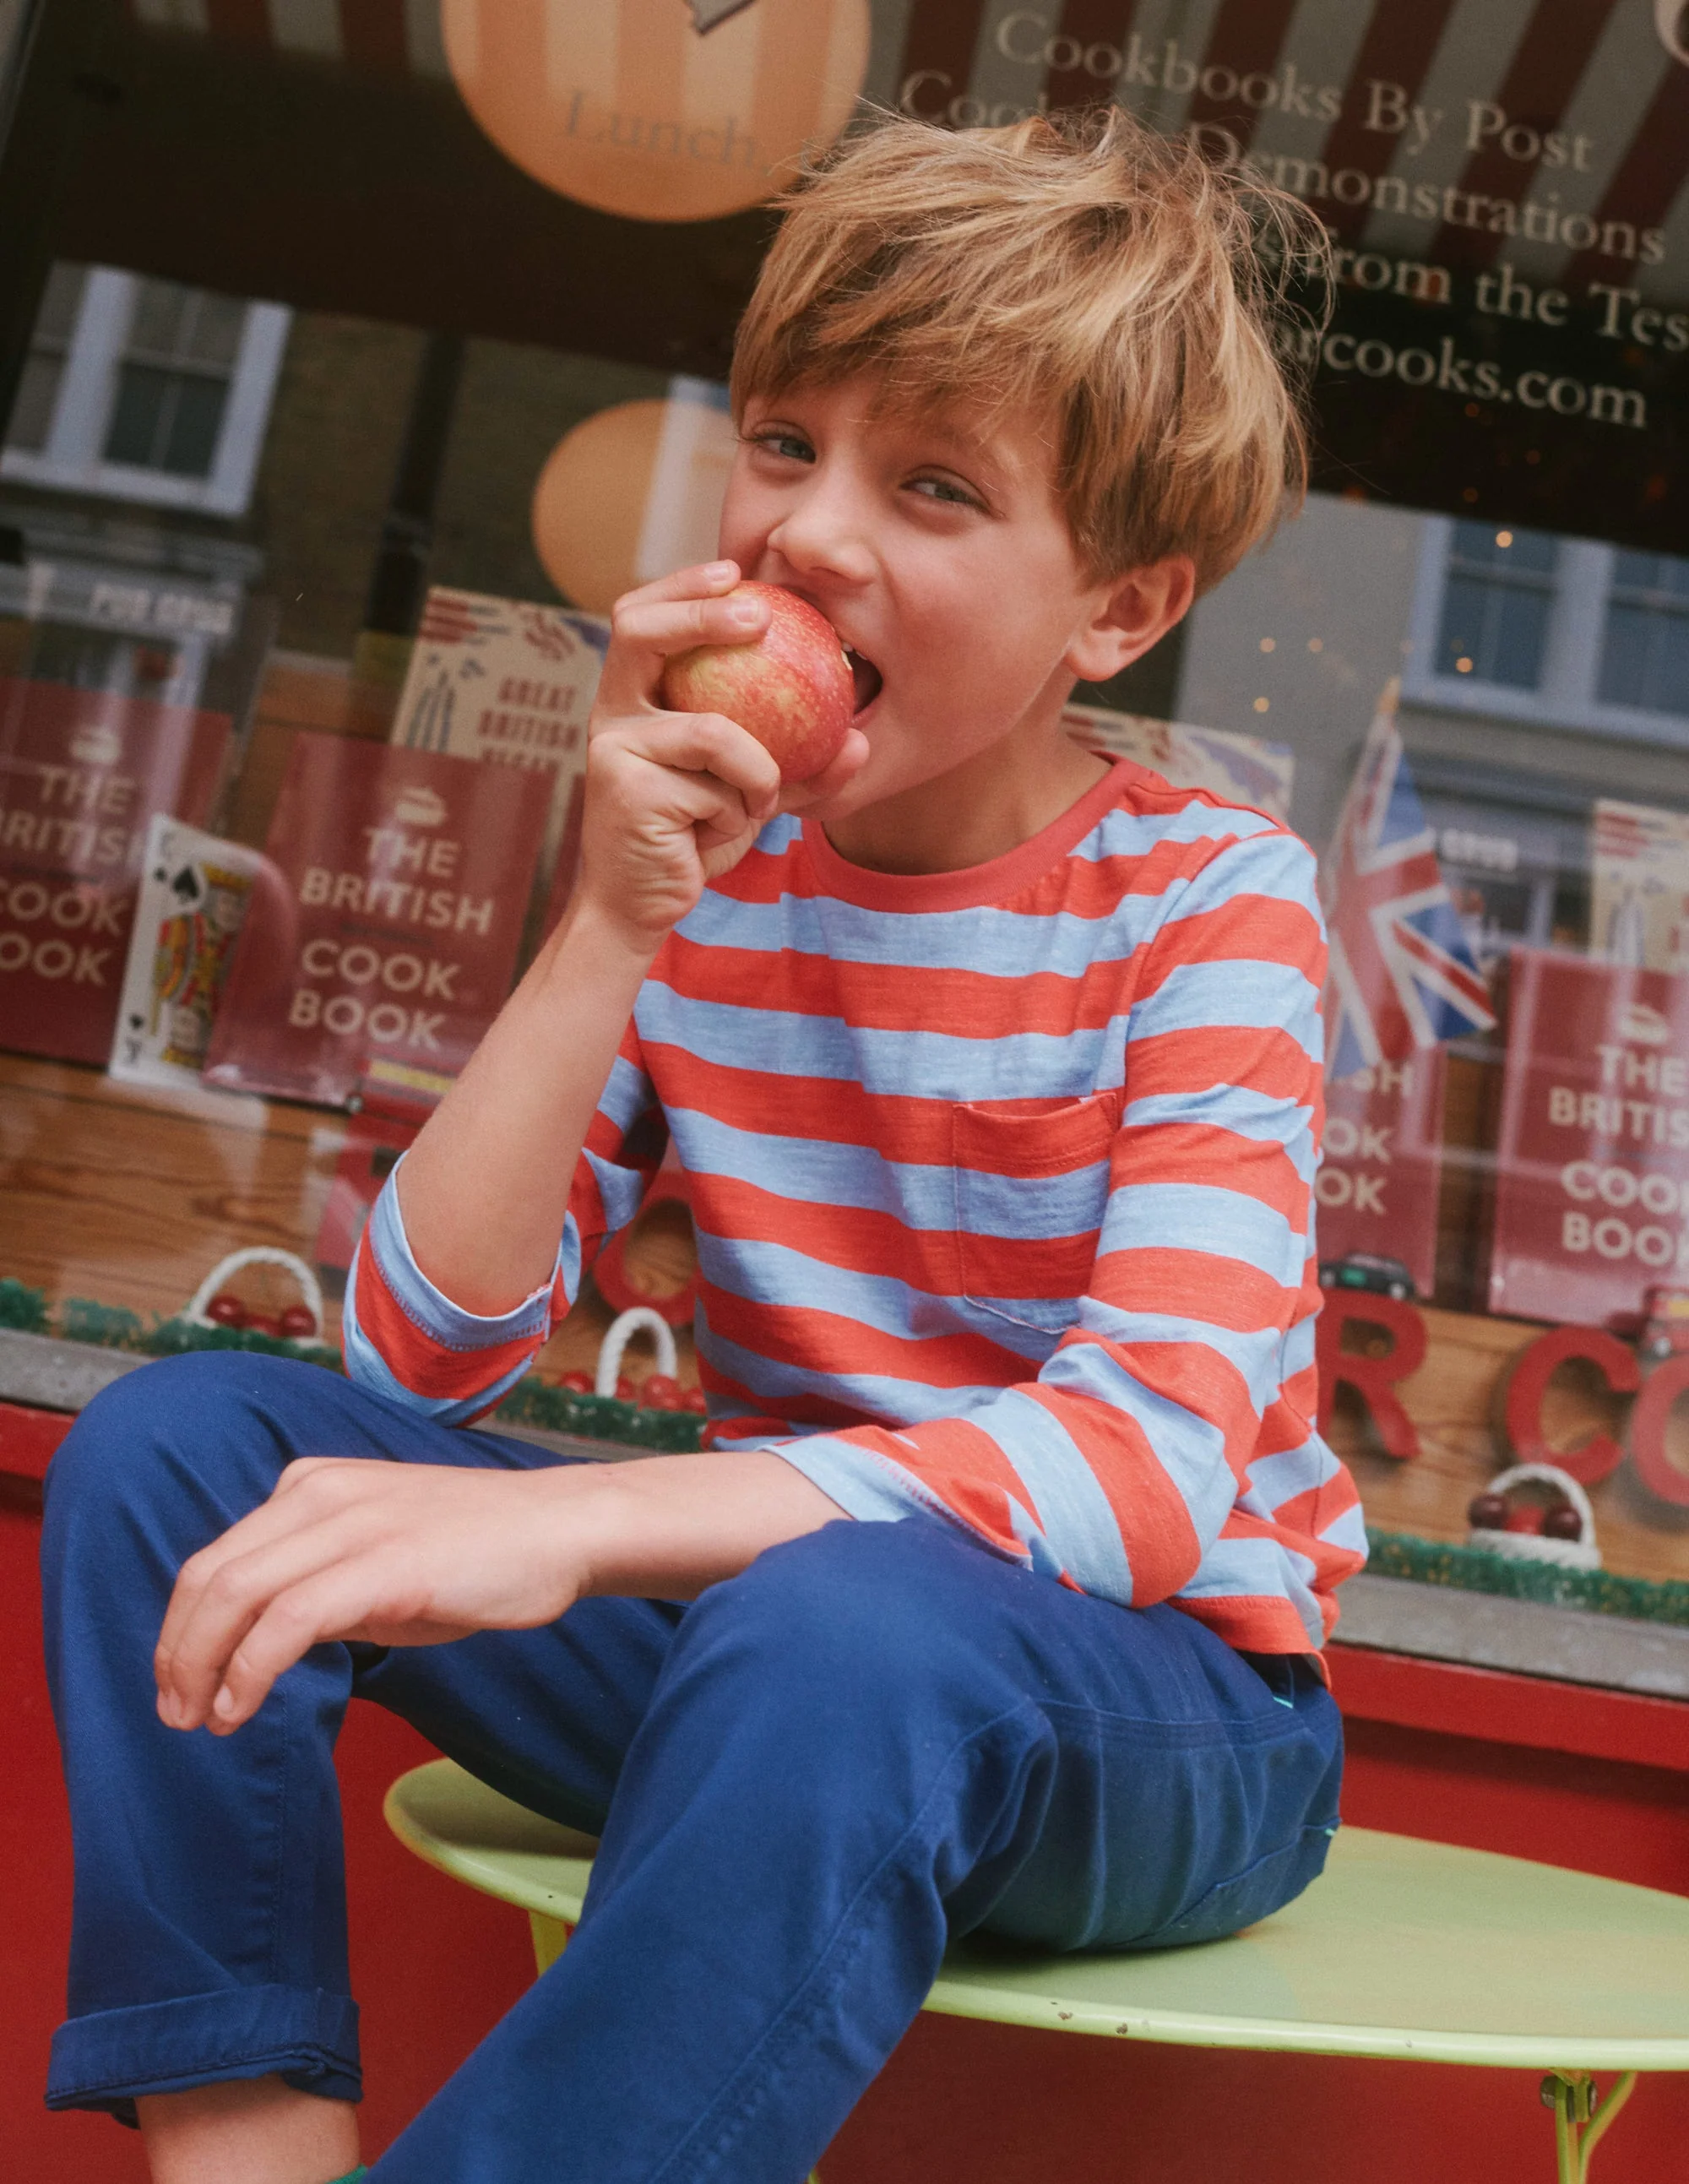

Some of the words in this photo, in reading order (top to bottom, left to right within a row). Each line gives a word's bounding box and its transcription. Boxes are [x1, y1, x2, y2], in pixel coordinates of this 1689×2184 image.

[997, 10, 1343, 122] Cookbooks
[1363, 77, 1446, 156] By
[1464, 98, 1596, 174] Post
[1475, 259, 1568, 327] the
[1587, 280, 1689, 353] Tes
[497, 676, 575, 714] GREAT
[478, 708, 581, 752] BRITISH
[39, 763, 135, 815] THE
[0, 807, 147, 875] RITIS
[363, 825, 461, 878] THE
[0, 878, 128, 937] OOK
[299, 865, 496, 936] BRITISH
[301, 938, 463, 1002] COOK
[287, 986, 448, 1052] BOOK
[1596, 1045, 1689, 1098] THE
